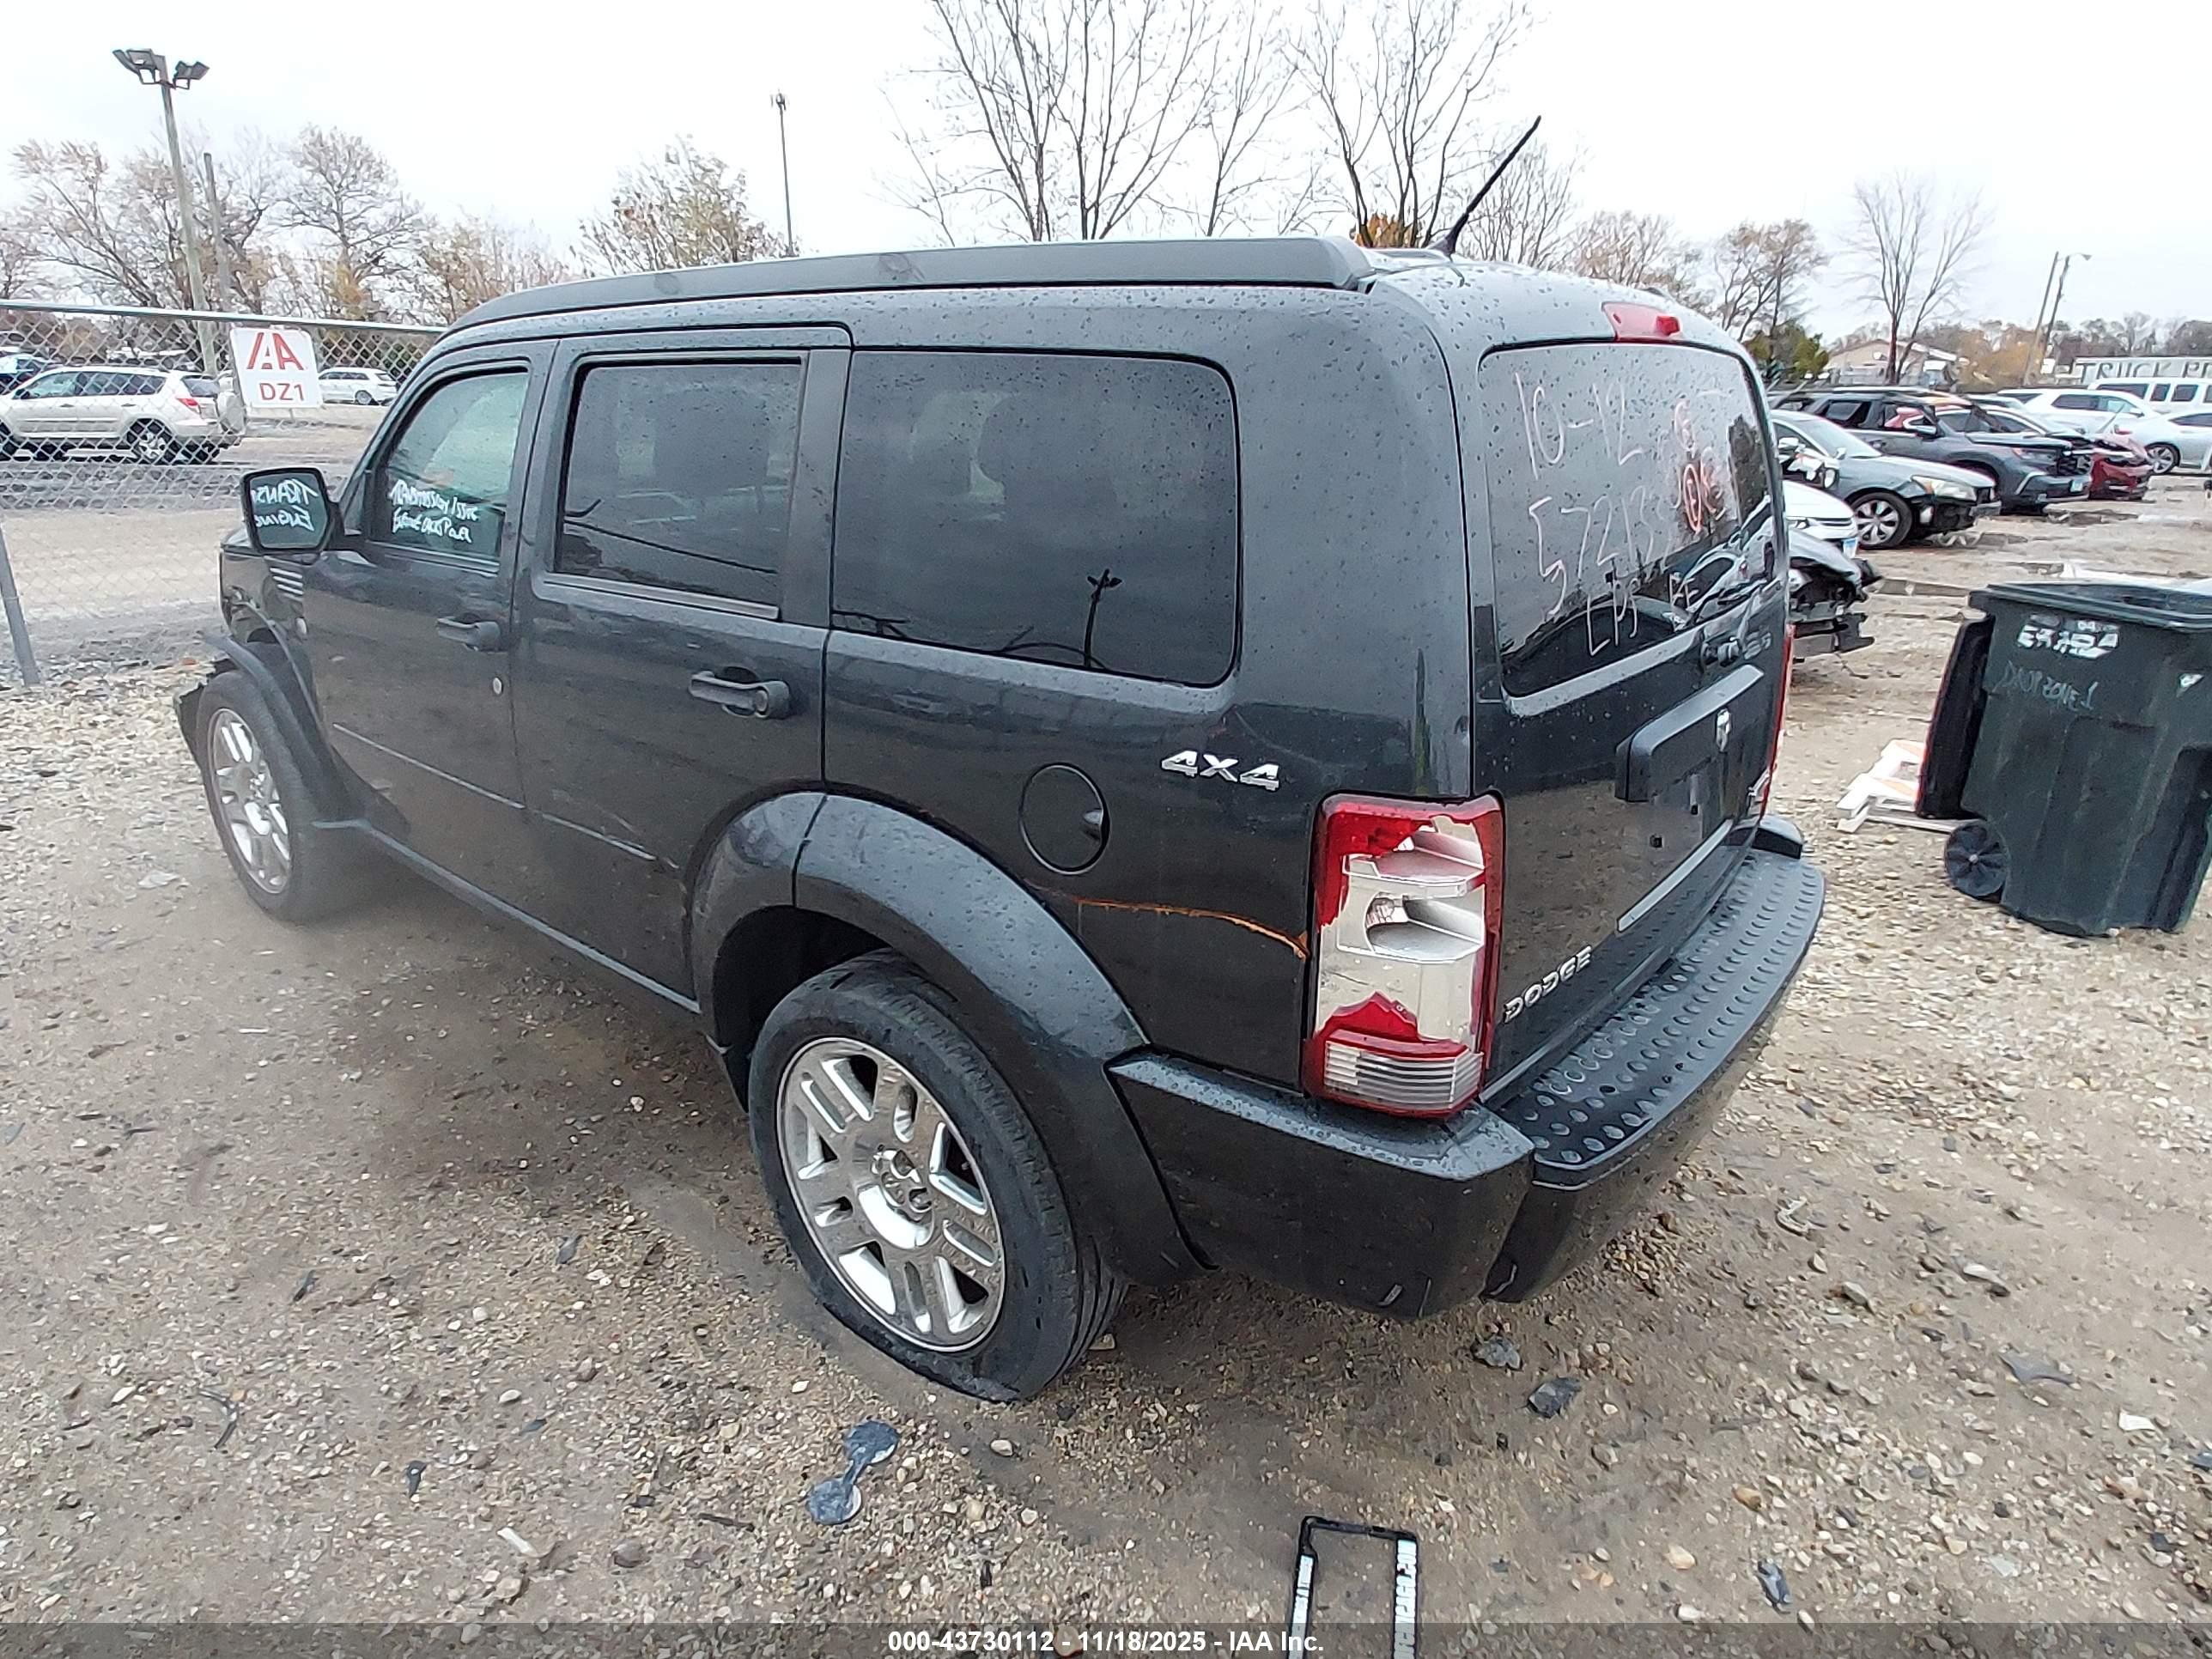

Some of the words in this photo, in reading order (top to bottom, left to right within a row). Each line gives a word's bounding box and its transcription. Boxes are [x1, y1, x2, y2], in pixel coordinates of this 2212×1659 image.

[259, 383, 305, 402] DZ1
[2075, 362, 2172, 383] TRUCK
[1514, 371, 1644, 481] 10-12
[1503, 945, 1592, 1023] DODGE
